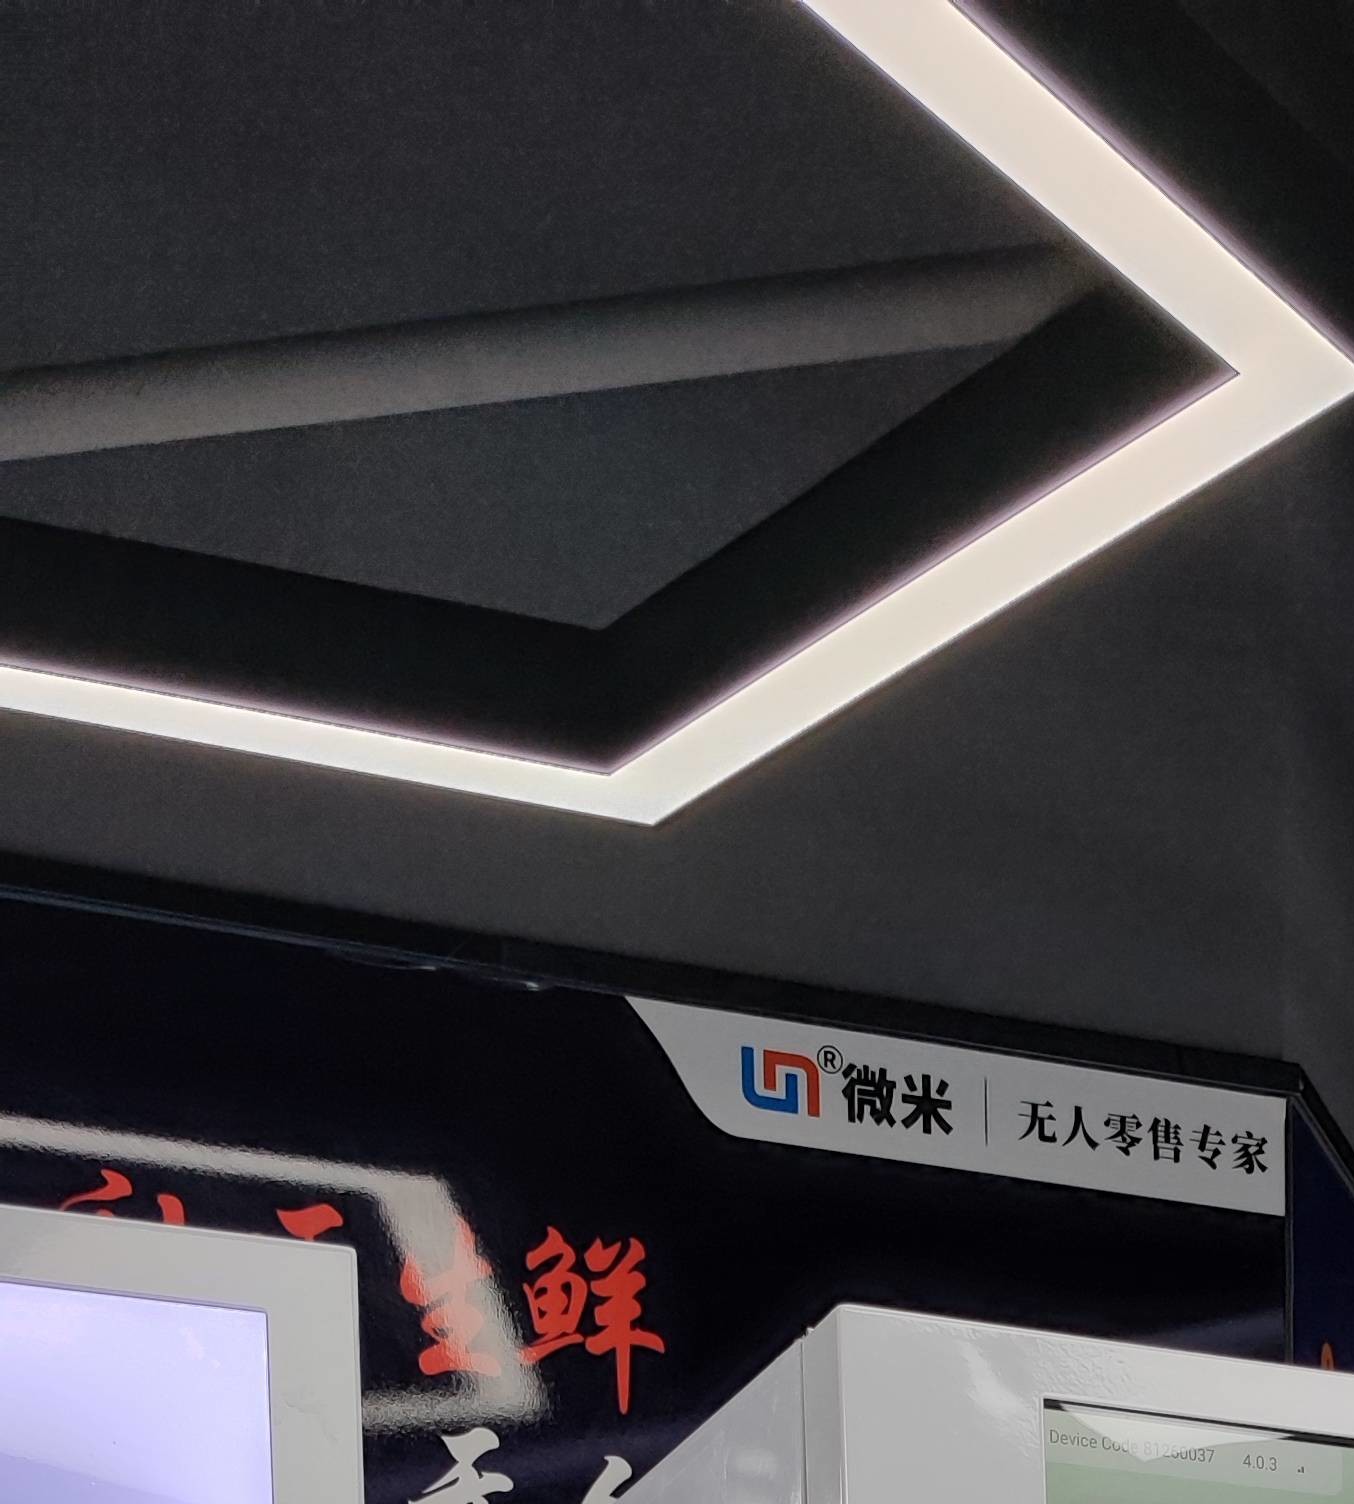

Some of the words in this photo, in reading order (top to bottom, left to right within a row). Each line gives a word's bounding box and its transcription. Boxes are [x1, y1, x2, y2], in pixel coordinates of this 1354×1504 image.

[841, 1061, 954, 1136] 微米
[1016, 1099, 1270, 1175] 无人零售专家
[1050, 1429, 1098, 1449] Device
[1242, 1453, 1278, 1472] 4.0.3
